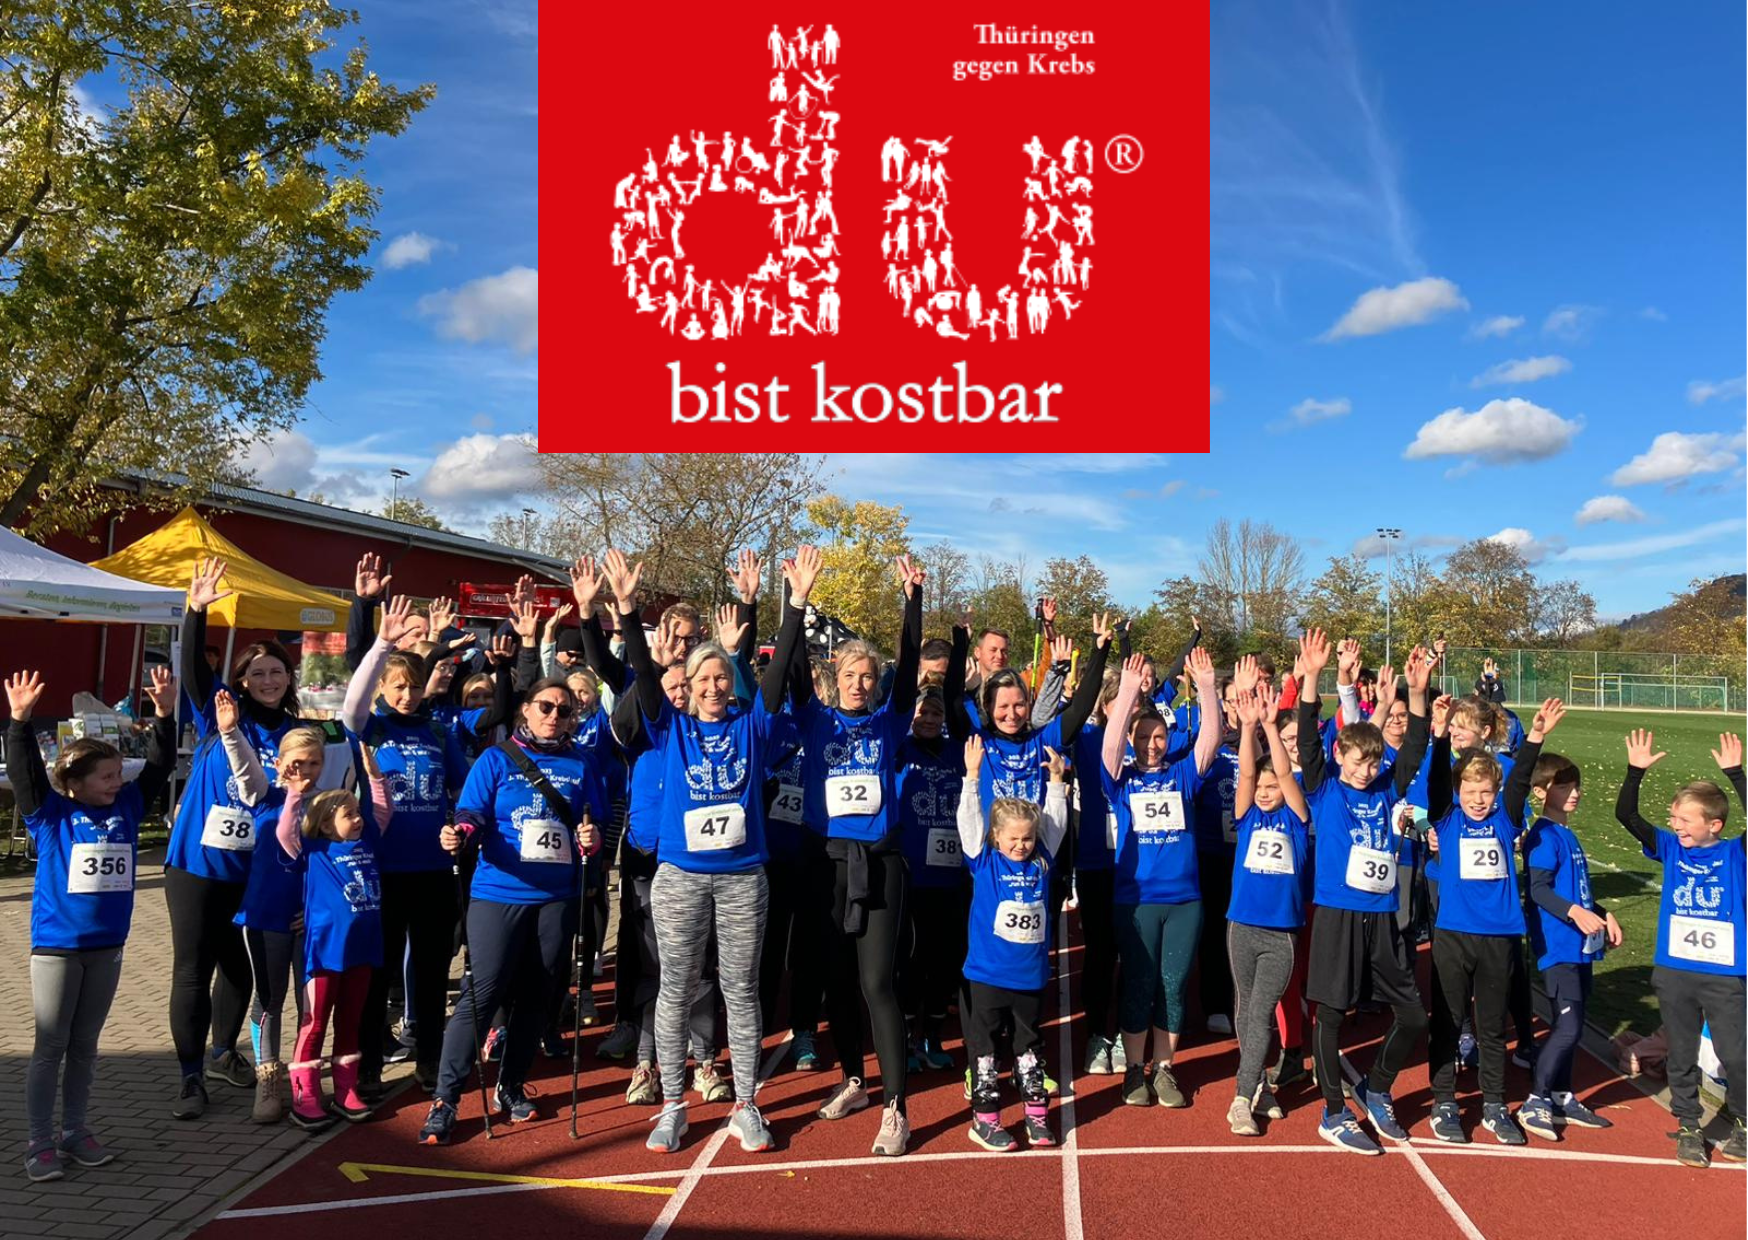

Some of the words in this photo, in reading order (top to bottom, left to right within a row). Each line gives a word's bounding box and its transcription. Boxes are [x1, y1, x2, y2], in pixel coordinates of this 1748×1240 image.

[840, 785, 868, 802] 32
[777, 795, 801, 812] 43
[1145, 801, 1171, 819] 54
[220, 820, 250, 839] 38
[700, 816, 730, 837] 47
[536, 831, 562, 850] 45
[1257, 841, 1283, 859] 52
[1473, 849, 1499, 867] 29
[82, 857, 126, 876] 356
[1363, 860, 1389, 881] 39
[1005, 912, 1041, 930] 383
[1683, 929, 1717, 949] 46
